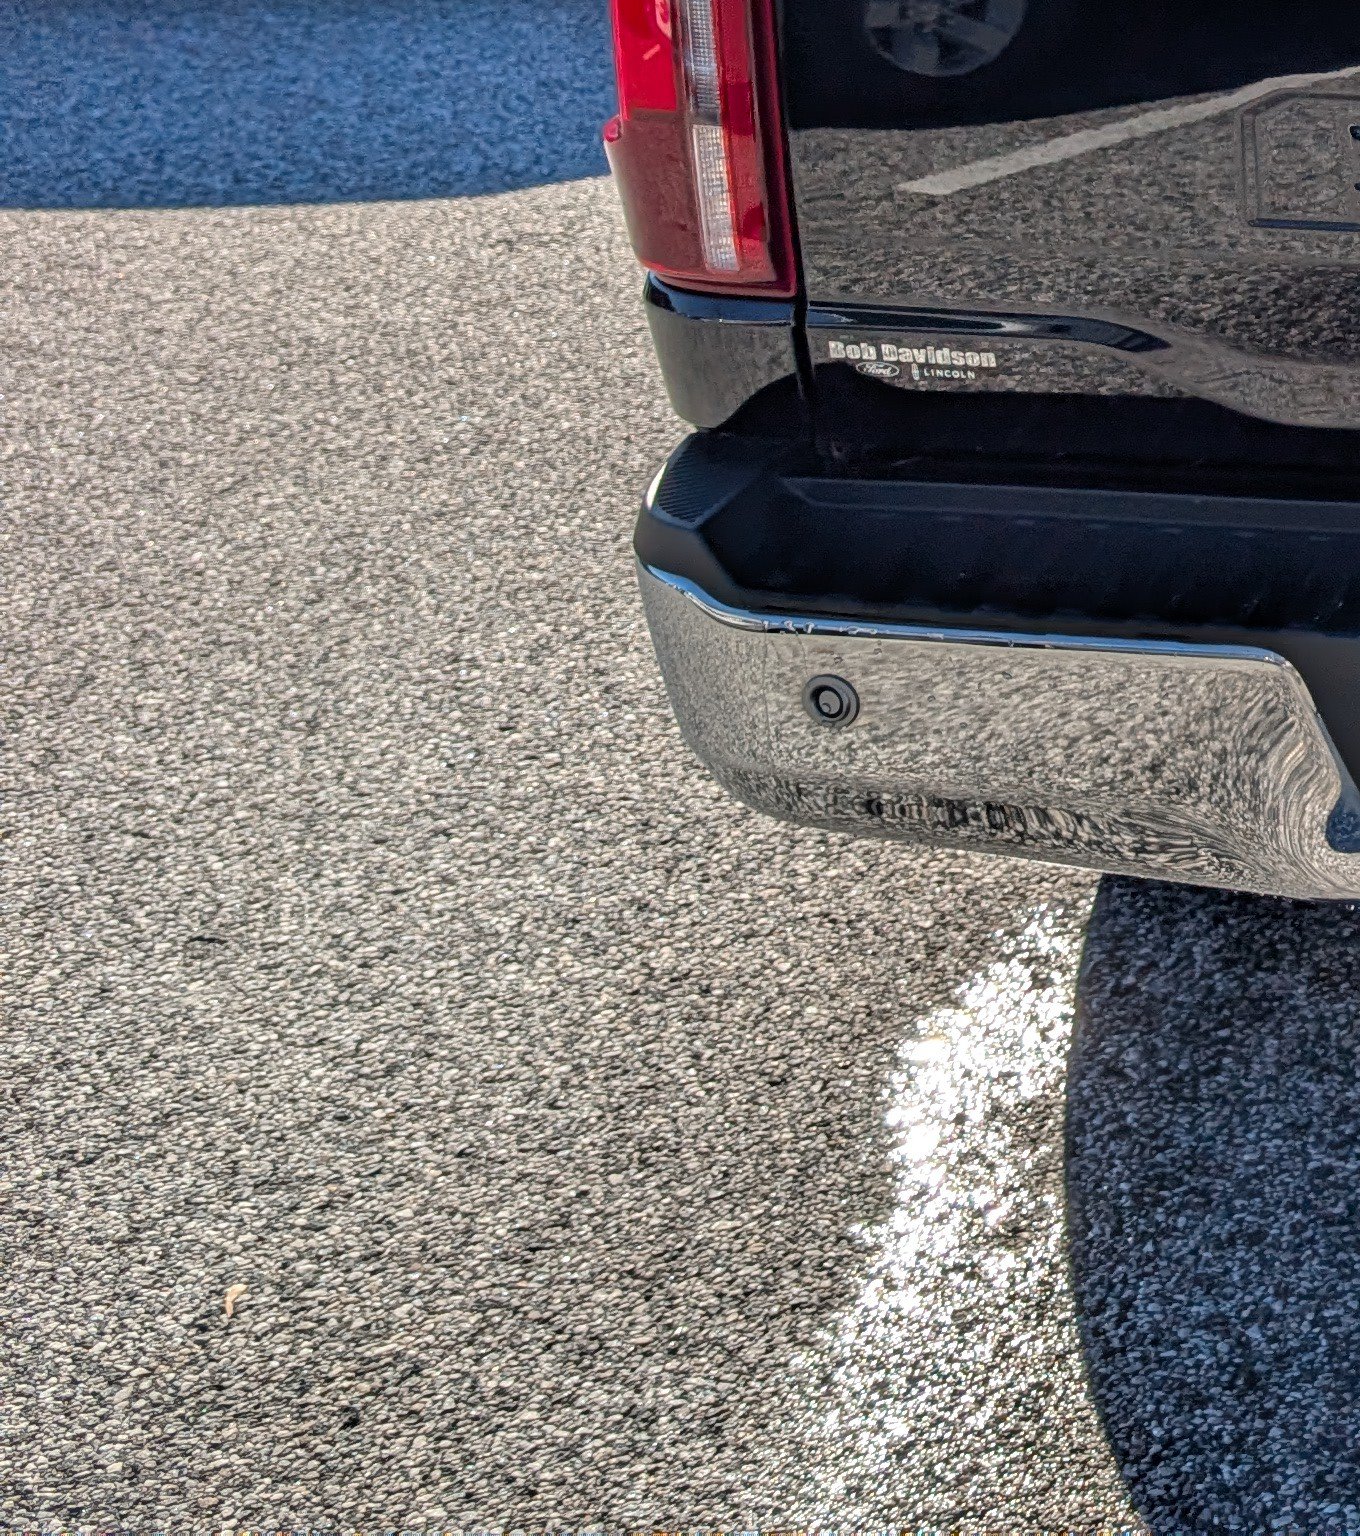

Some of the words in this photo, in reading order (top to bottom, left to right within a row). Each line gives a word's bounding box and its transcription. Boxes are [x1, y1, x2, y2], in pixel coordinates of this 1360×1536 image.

[828, 340, 877, 361] Bob
[880, 343, 997, 368] Davidson
[923, 368, 976, 380] LINCOLN
